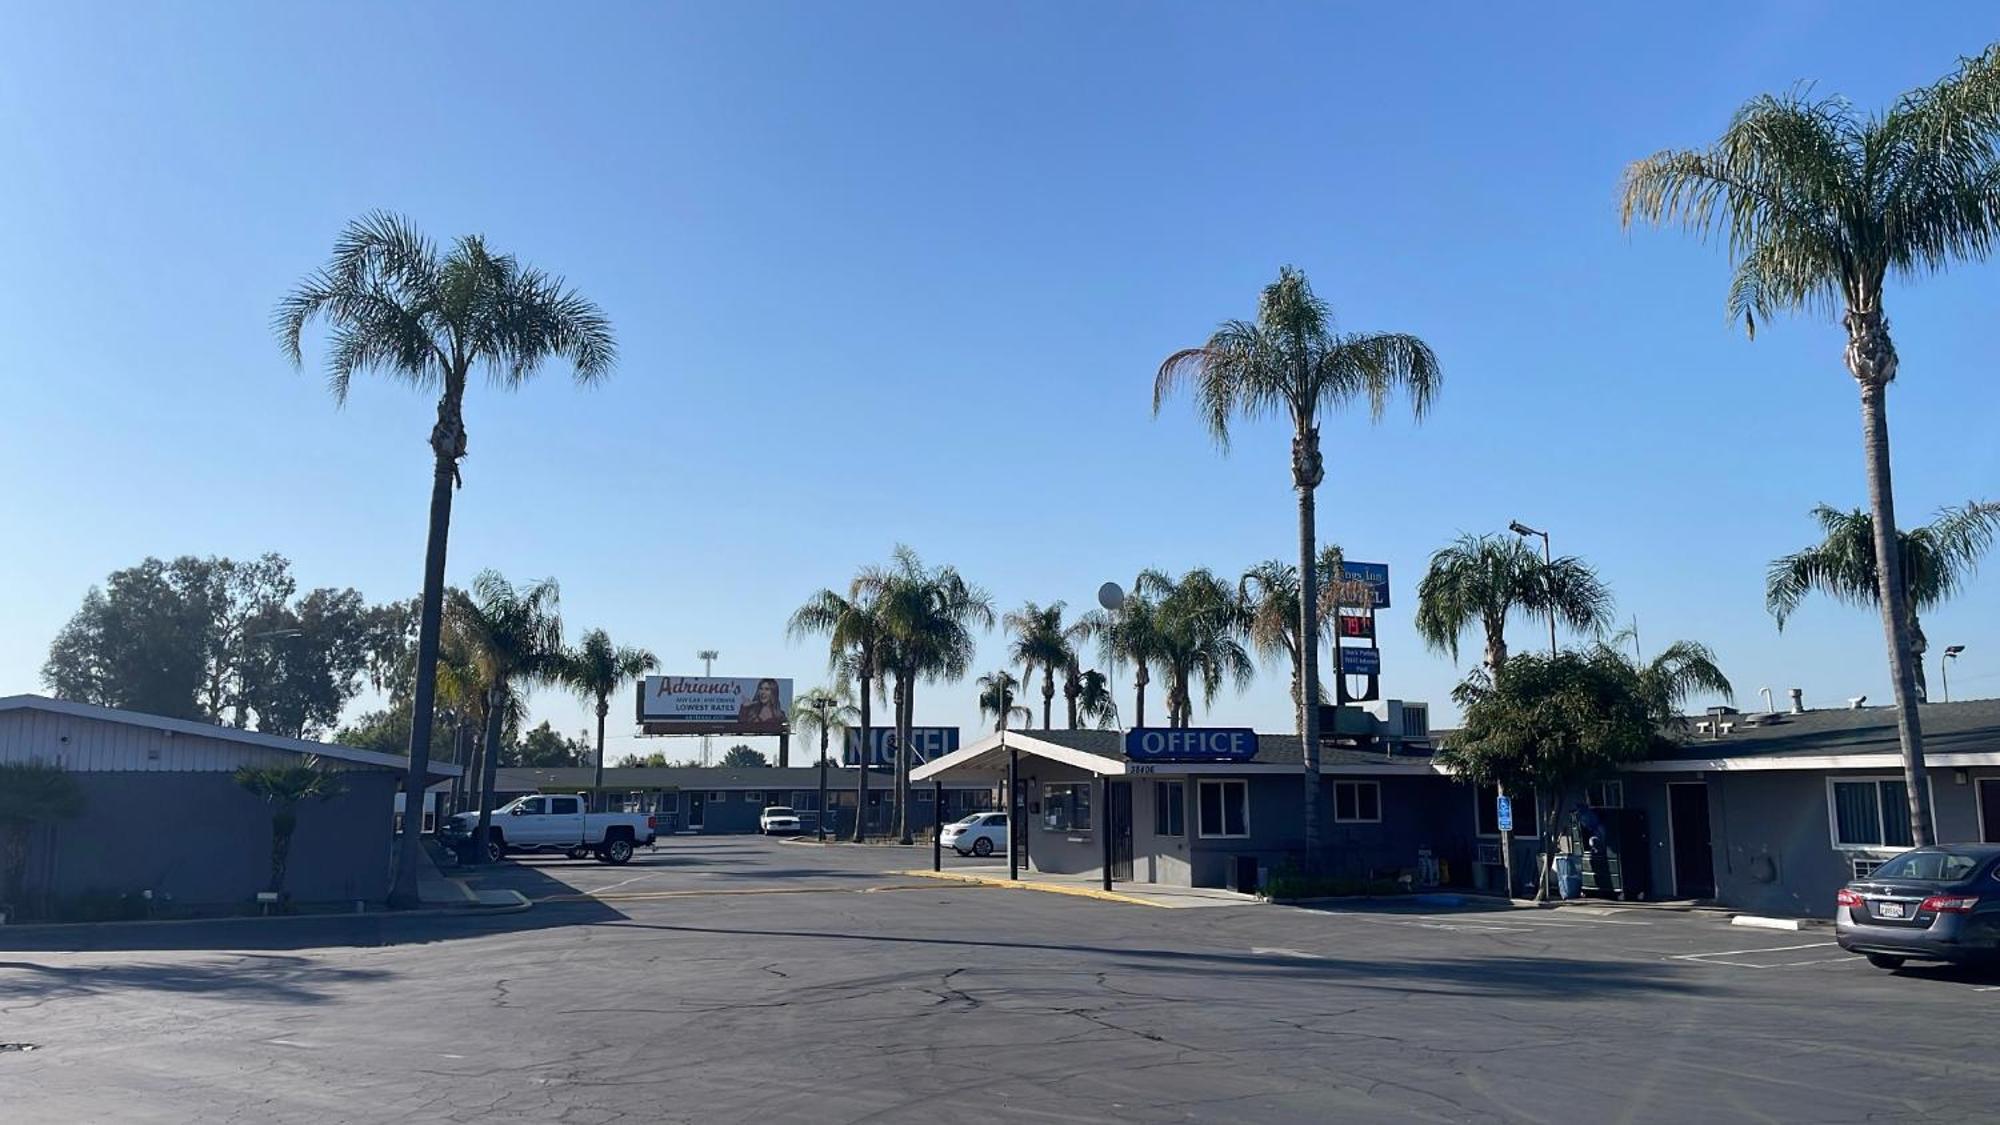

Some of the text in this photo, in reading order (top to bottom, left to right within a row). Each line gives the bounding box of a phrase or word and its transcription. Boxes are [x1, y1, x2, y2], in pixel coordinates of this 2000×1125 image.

[657, 676, 742, 697] Adriana's
[675, 703, 736, 711] LOWEST RATES
[1142, 731, 1244, 754] OFFICE
